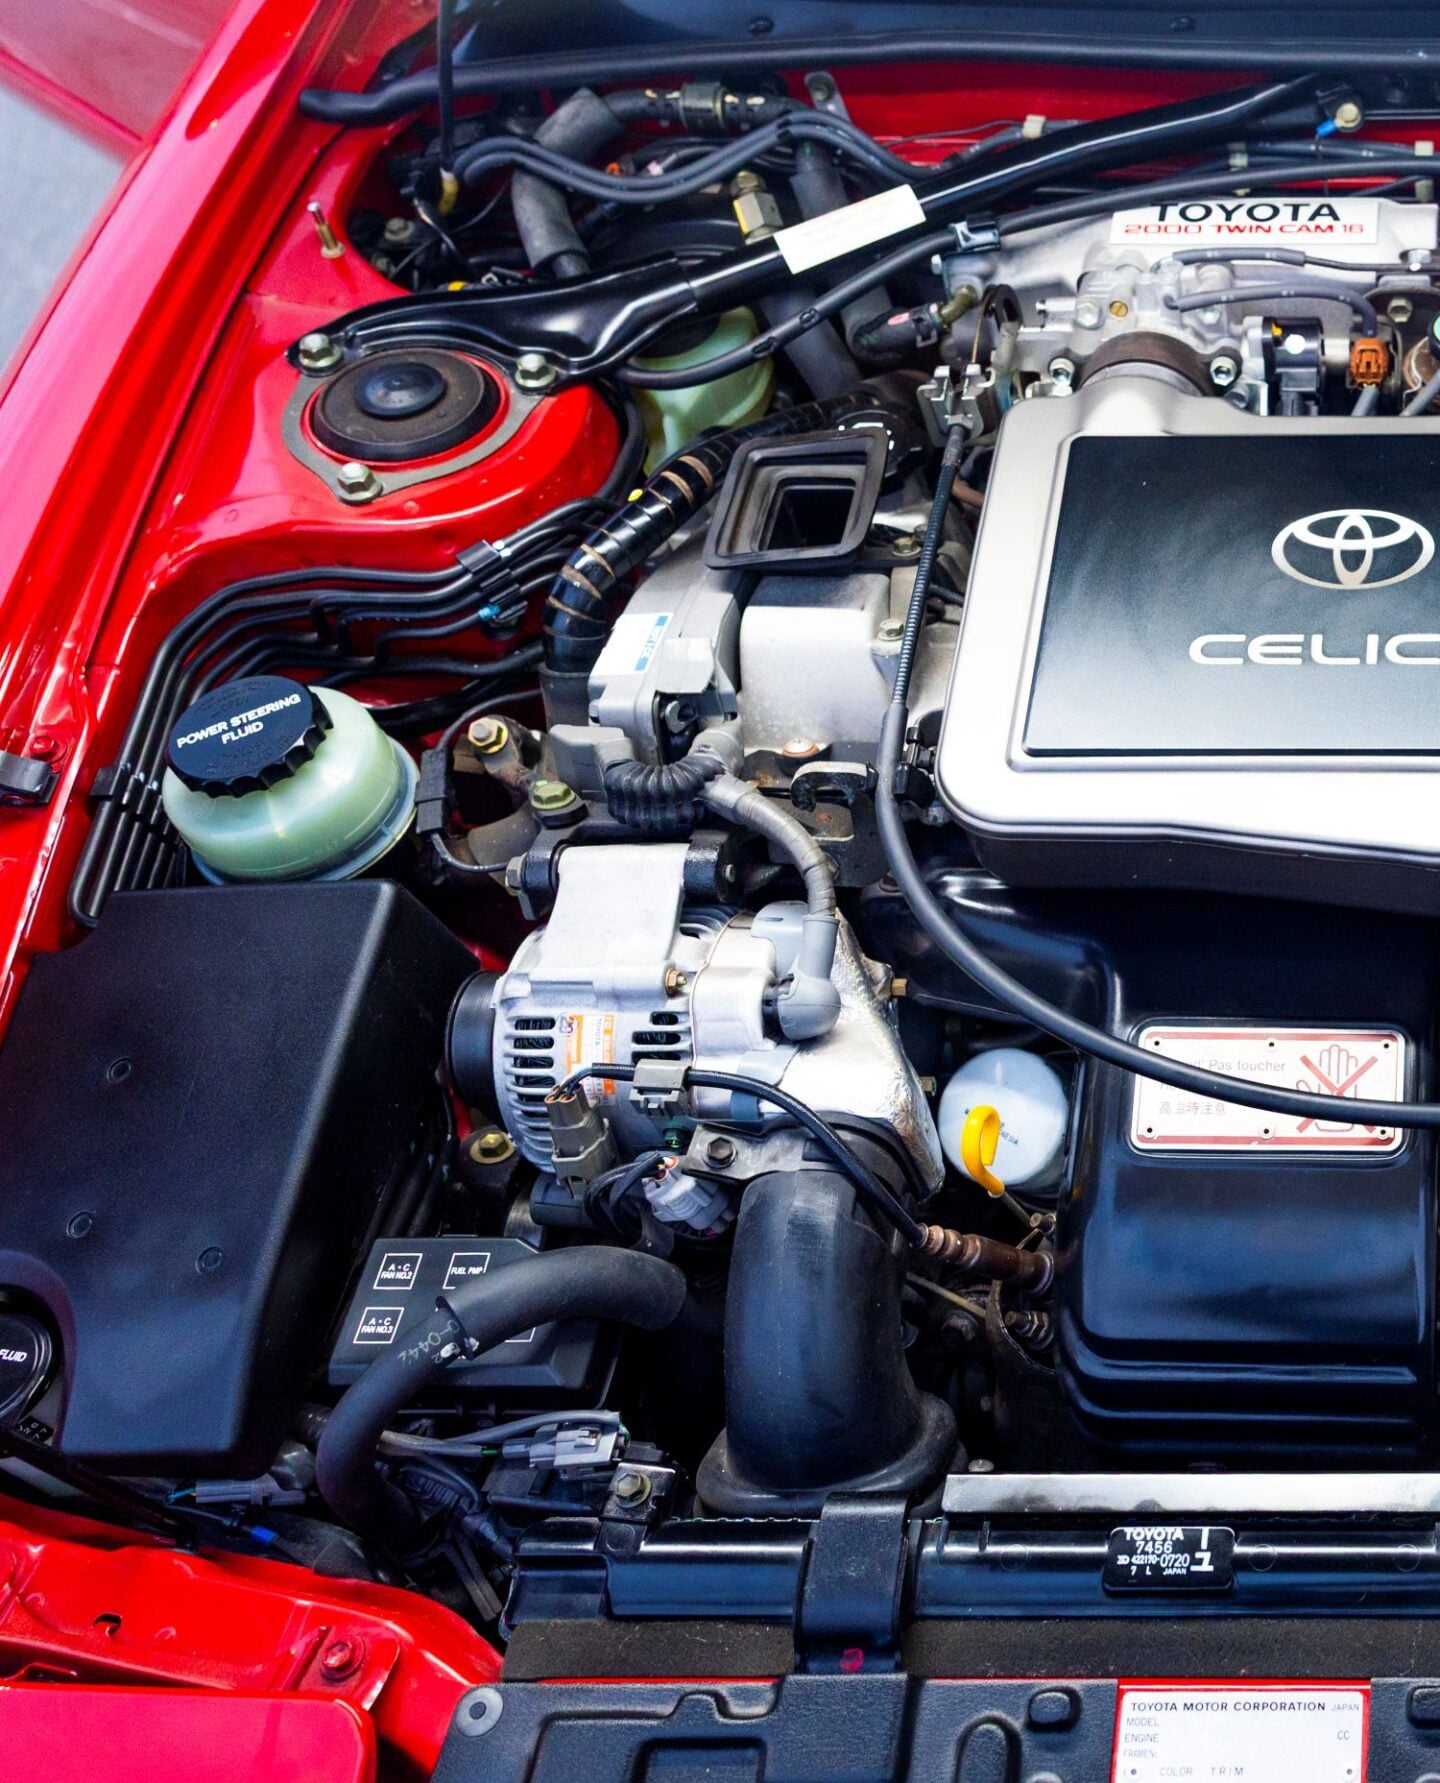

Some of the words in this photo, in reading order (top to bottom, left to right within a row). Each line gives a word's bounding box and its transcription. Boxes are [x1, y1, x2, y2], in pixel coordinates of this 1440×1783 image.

[1152, 203, 1340, 222] TOYOTA
[1124, 224, 1202, 234] 2000
[1214, 224, 1273, 234] TWIN
[1279, 224, 1334, 234] CAM
[1342, 224, 1364, 234] 16
[177, 721, 228, 748] POWER
[230, 693, 301, 728] STEERING
[221, 721, 264, 745] FLUID
[1208, 1059, 1233, 1071] Pas
[1237, 1059, 1286, 1072] toucher
[450, 1266, 467, 1275] FUEL
[0, 1348, 28, 1363] FLUID
[1124, 1527, 1185, 1541] TOYOTA
[1136, 1540, 1173, 1554] 7456
[1145, 1565, 1152, 1576] L
[1162, 1567, 1187, 1576] JAPAN
[1131, 1702, 1178, 1712] TOYOTA
[1183, 1702, 1228, 1712] MOTOR
[1233, 1701, 1326, 1711] CORPORATION
[1331, 1703, 1360, 1711] JAPAN
[1126, 1717, 1160, 1727] MODEL
[1124, 1733, 1159, 1743] ENGINE
[1336, 1730, 1350, 1741] CC
[1159, 1767, 1193, 1777] COLOR
[1210, 1766, 1244, 1777] TRIM
